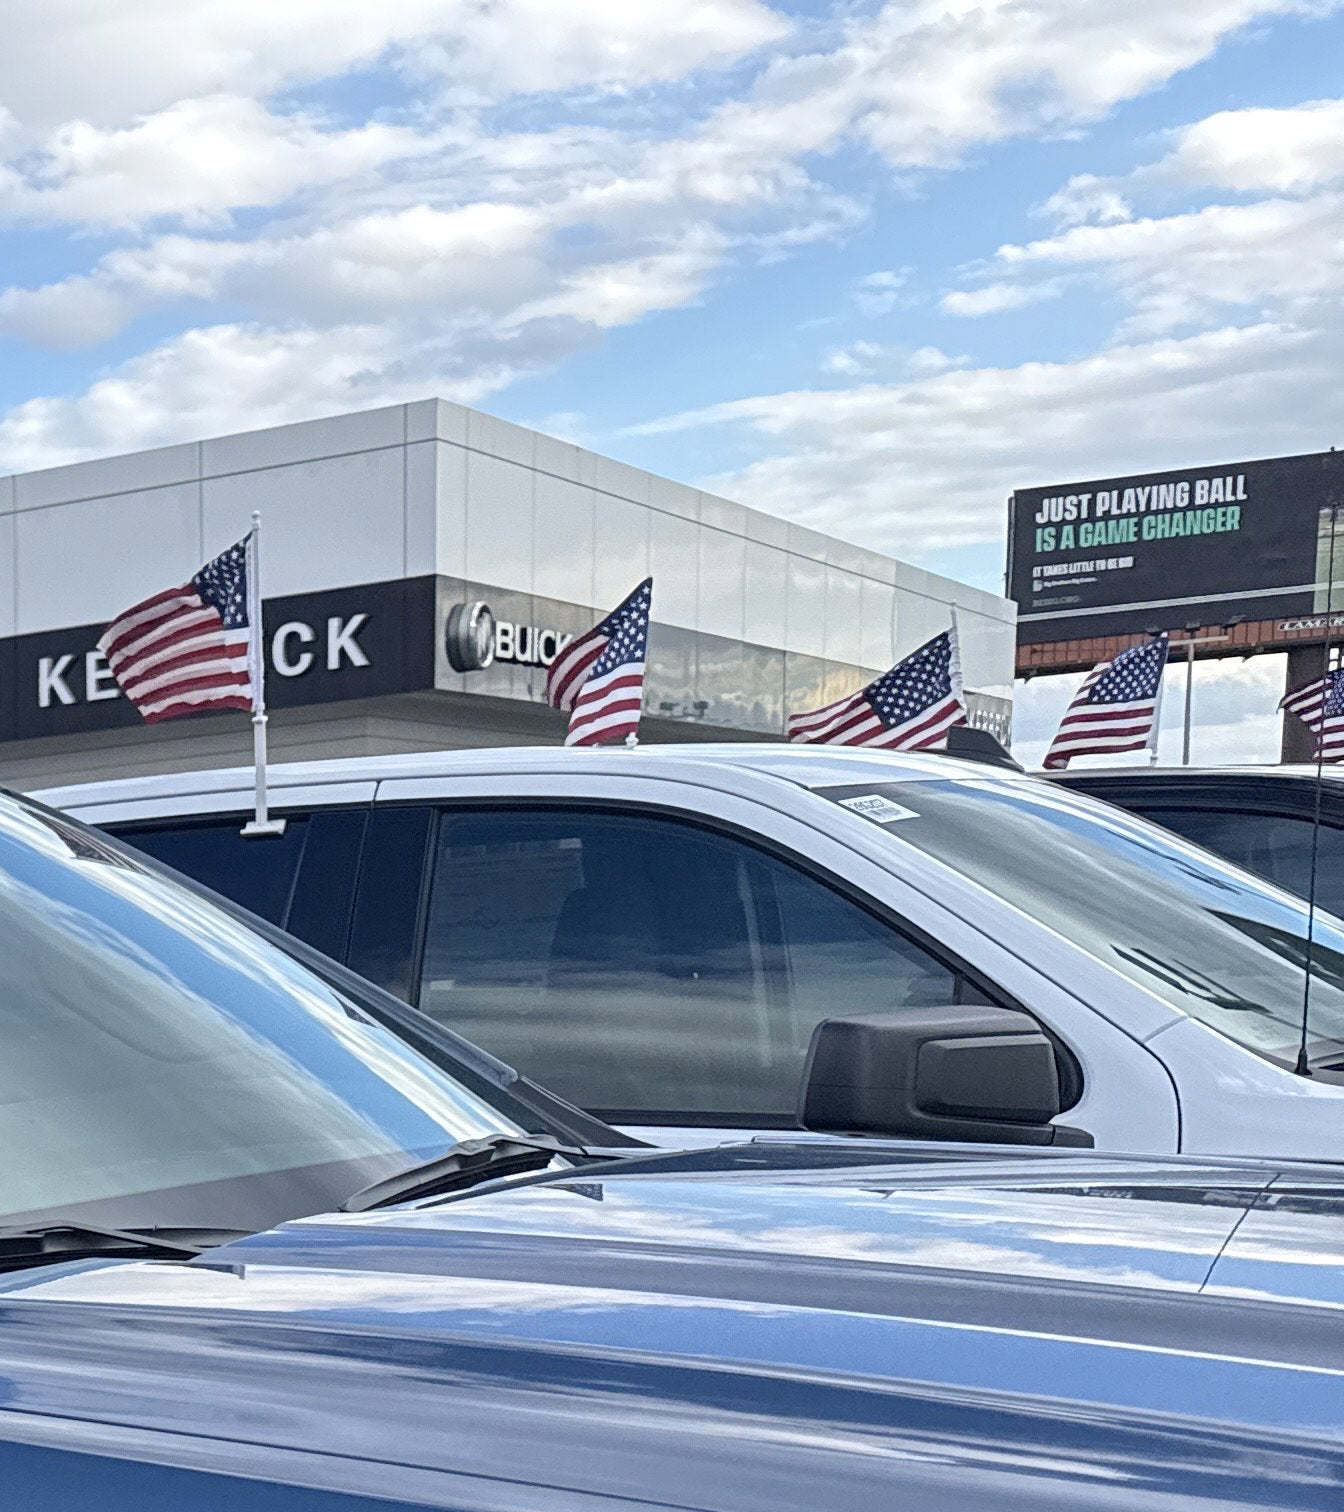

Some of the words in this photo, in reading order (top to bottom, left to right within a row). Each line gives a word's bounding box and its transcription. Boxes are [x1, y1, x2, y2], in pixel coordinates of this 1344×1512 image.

[1035, 494, 1092, 524] JUST
[1096, 482, 1190, 517] PLAYING
[1195, 475, 1248, 506] BALL
[1035, 526, 1056, 553] IS
[1060, 525, 1075, 549] A
[1079, 517, 1138, 548] GAME
[1142, 505, 1240, 541] CHANGER
